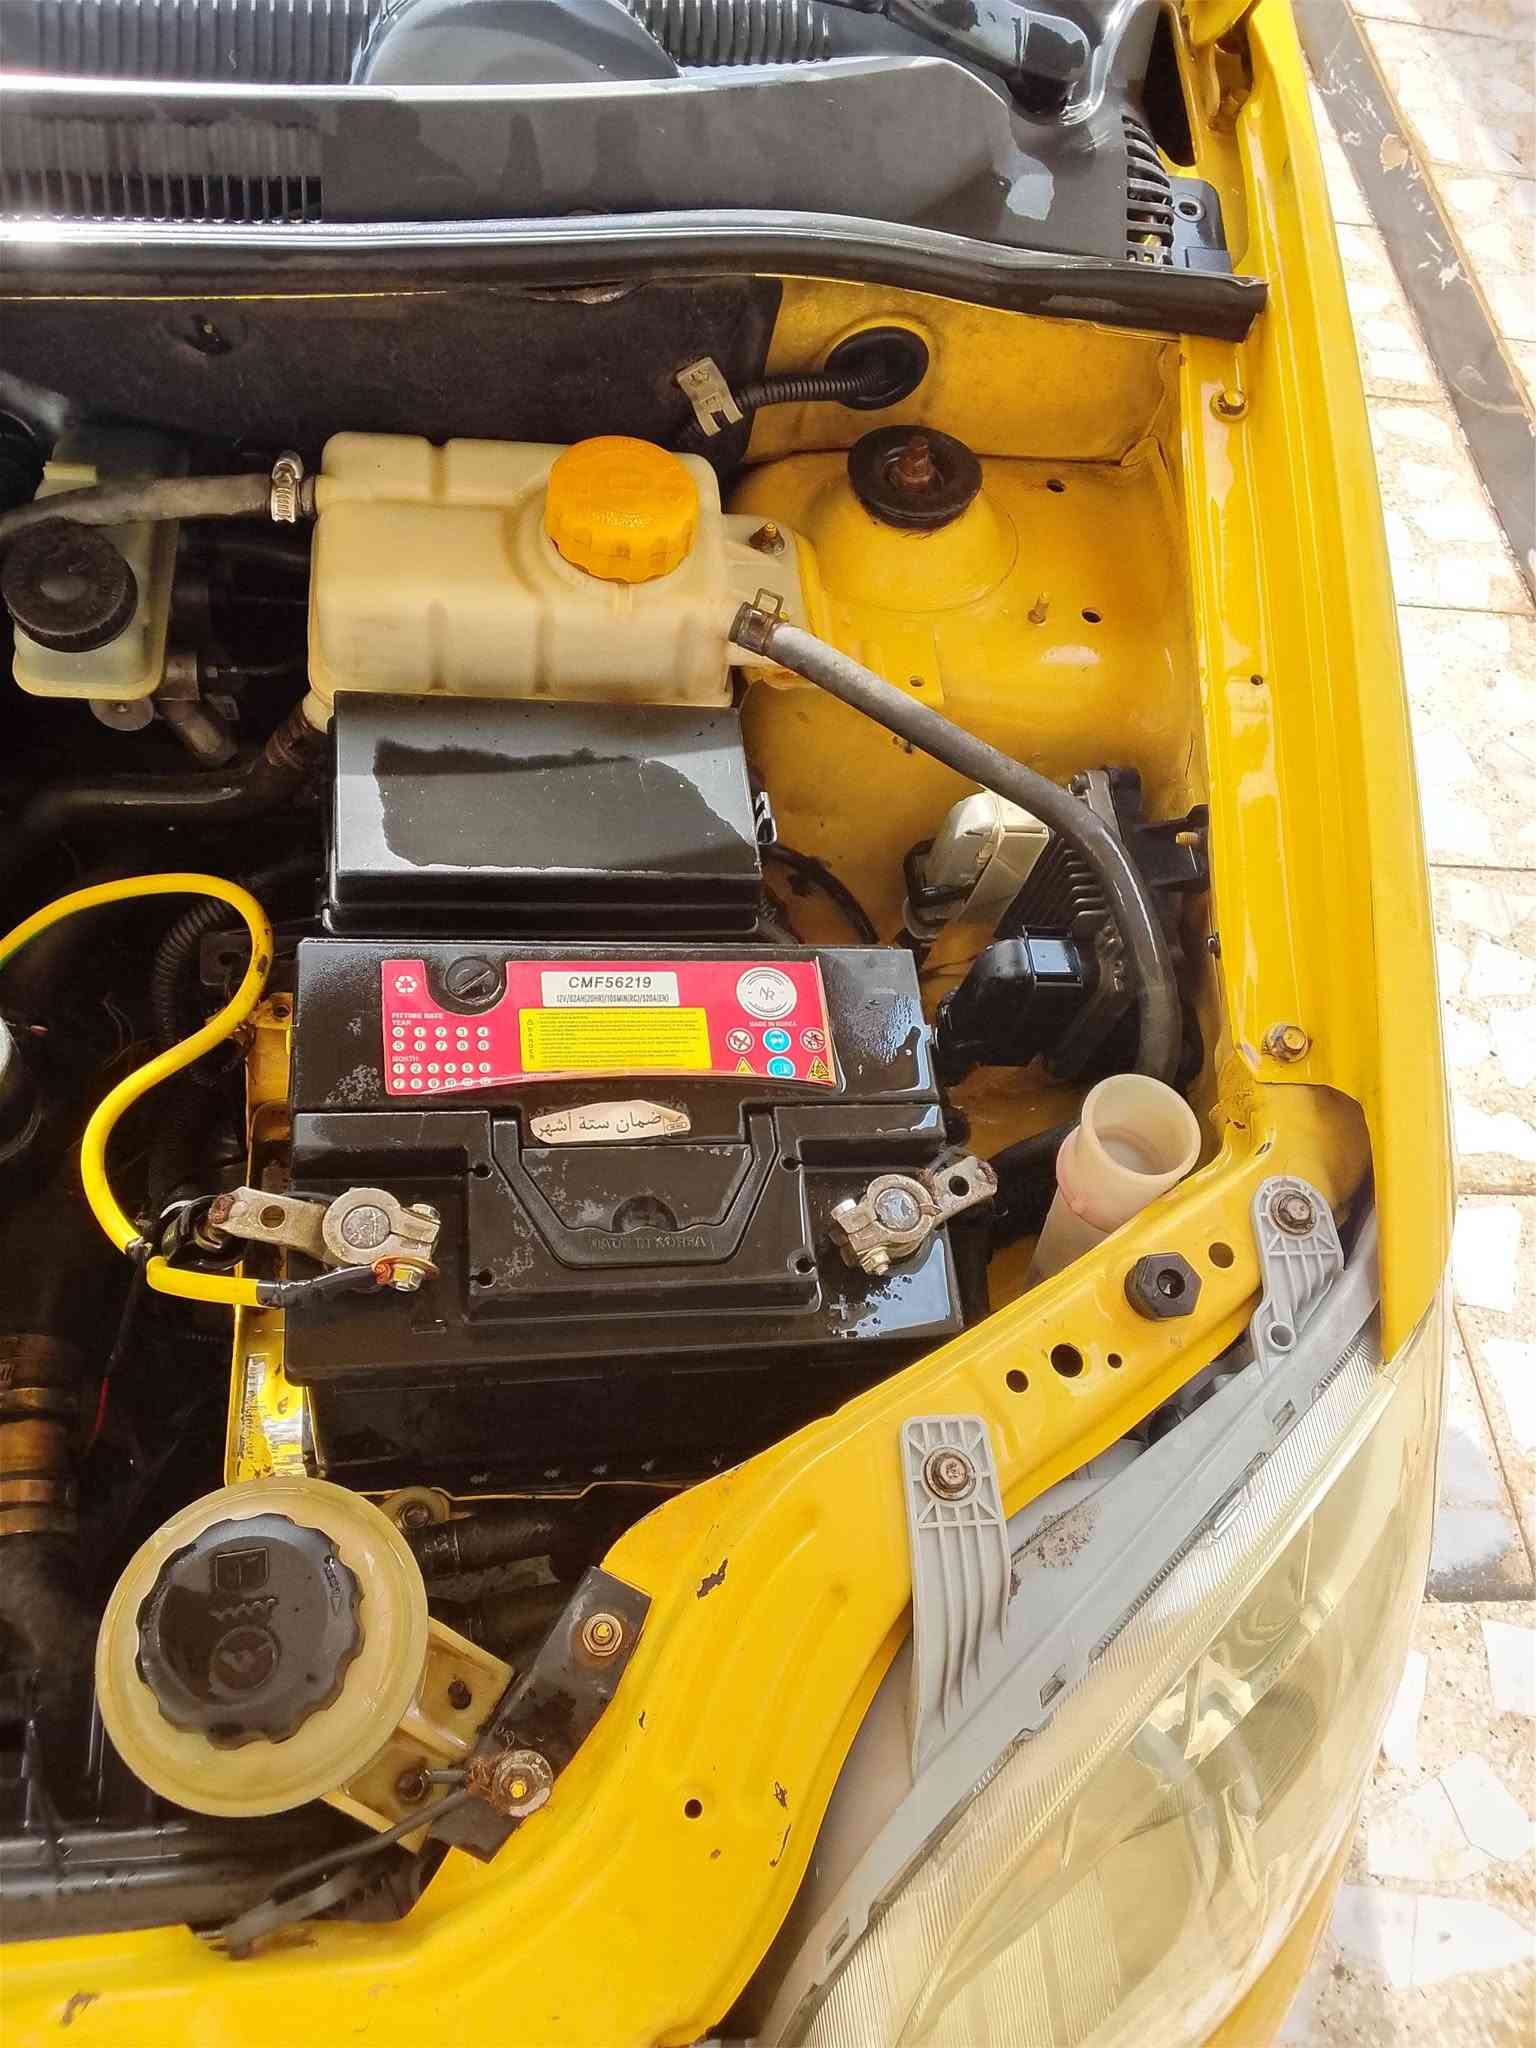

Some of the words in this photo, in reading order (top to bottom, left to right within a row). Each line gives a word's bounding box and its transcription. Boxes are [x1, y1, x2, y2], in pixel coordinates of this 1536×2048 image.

[568, 976, 652, 988] CMF56219
[538, 1111, 573, 1137] أشهر
[579, 1117, 609, 1130] ستة
[616, 1111, 662, 1133] ضمان
